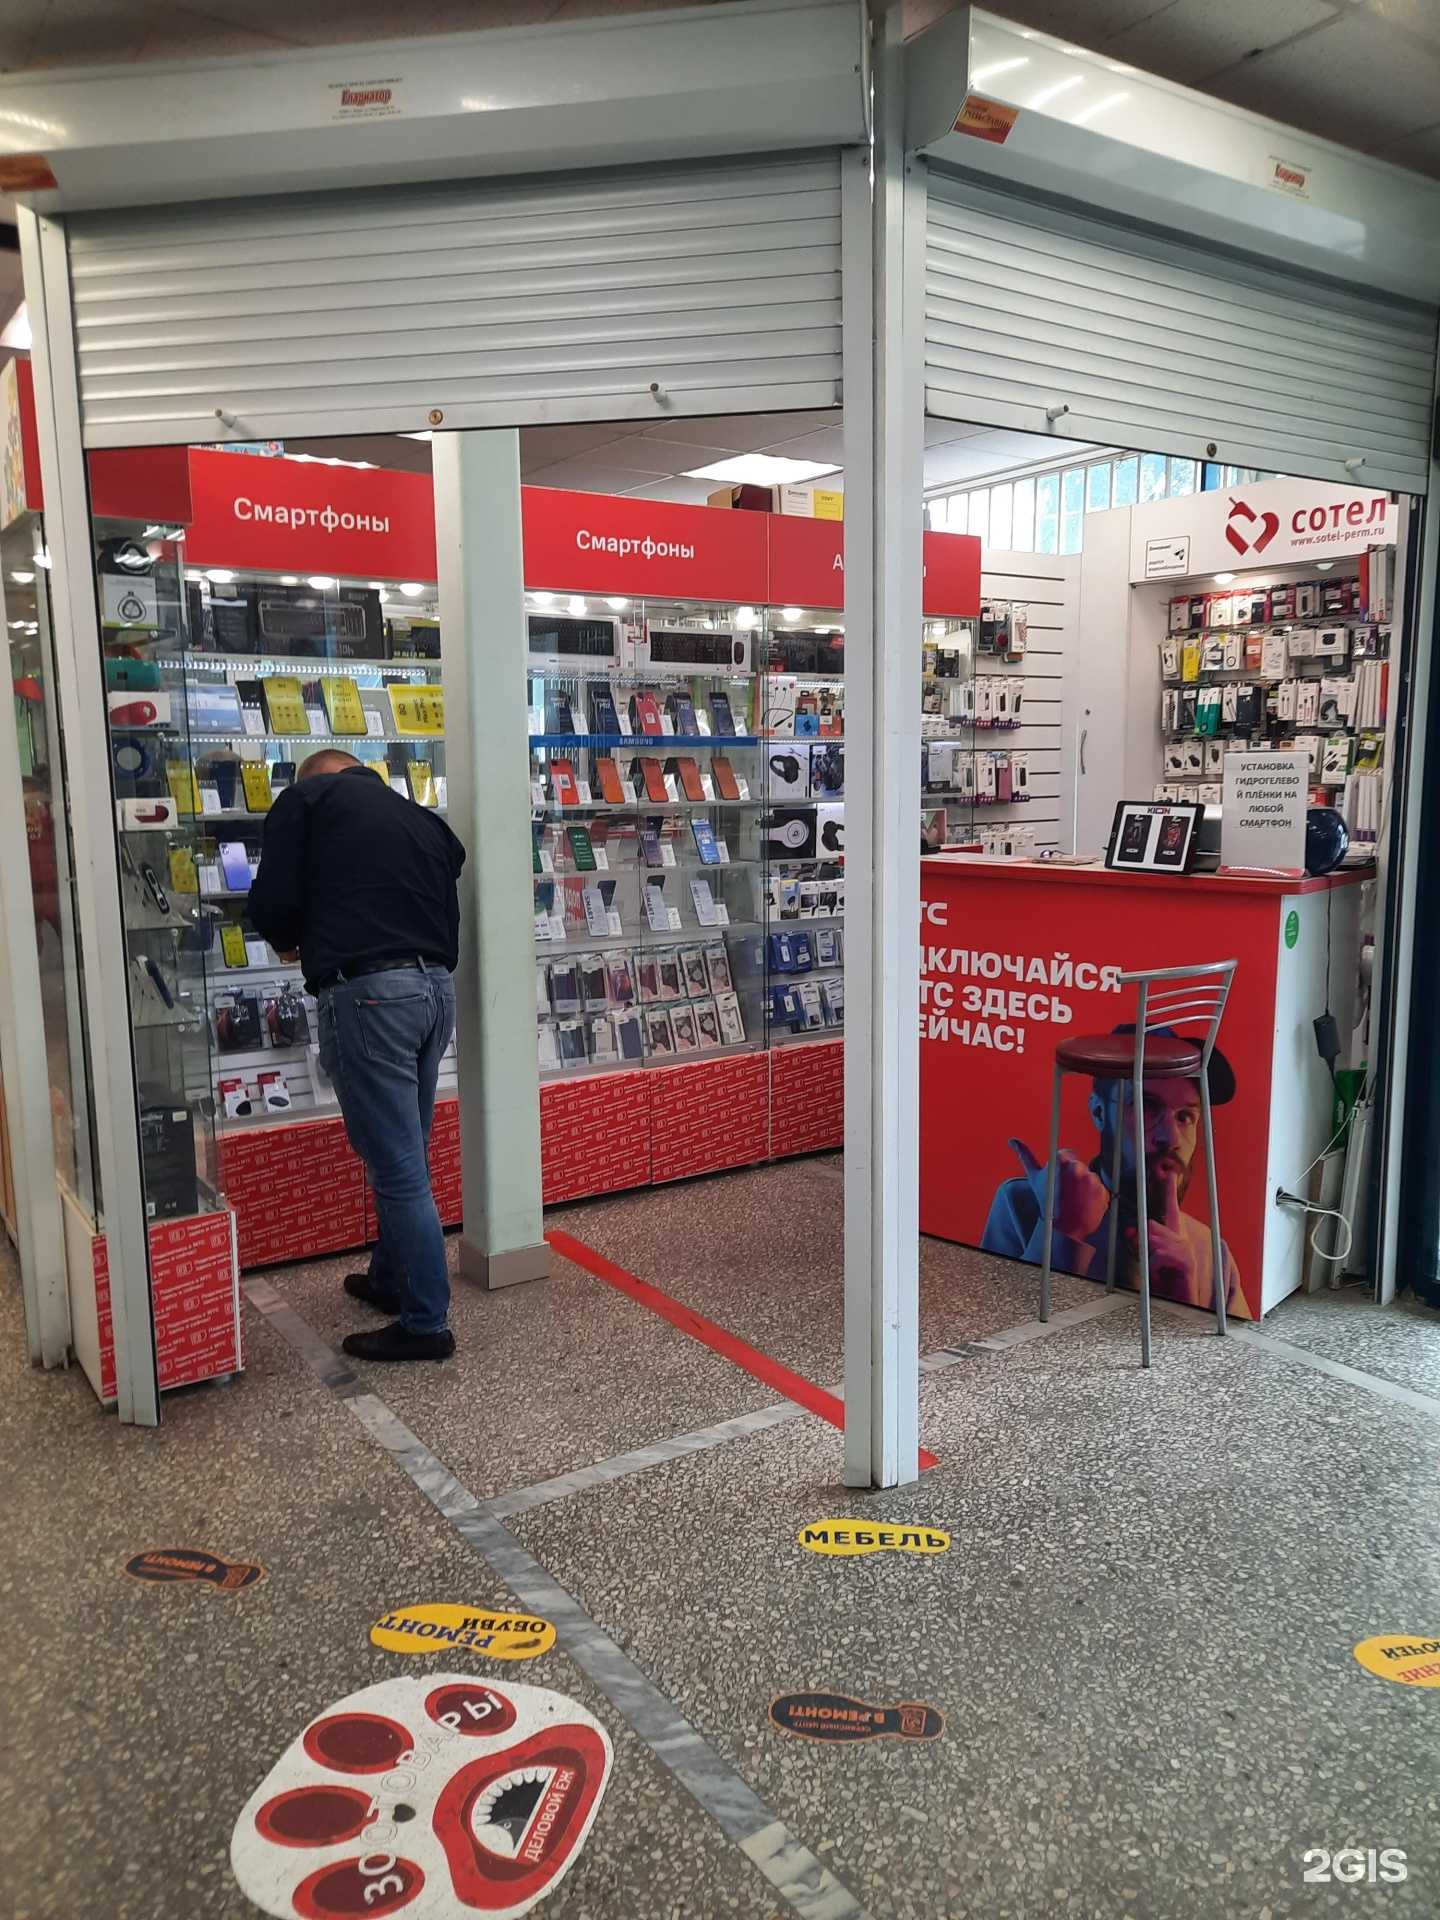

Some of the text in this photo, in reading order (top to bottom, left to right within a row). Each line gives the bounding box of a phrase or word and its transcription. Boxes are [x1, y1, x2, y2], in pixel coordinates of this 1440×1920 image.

[233, 497, 390, 533] Смартфоны
[576, 529, 695, 559] Смартфоны
[1290, 526, 1385, 547] www.sotel-perm.ru
[1240, 763, 1295, 772] УСТАНОВКА
[1235, 776, 1300, 786] ГИДРОГЕЛЕВО
[1284, 791, 1297, 799] НА
[1248, 804, 1284, 813] ЛЮБОЙ
[1239, 819, 1292, 828] СМАРТФОН
[919, 901, 948, 926] ТС
[919, 980, 1073, 1024] ТС ЗДЕСЬ
[918, 1008, 1025, 1054] ЕЙЧАС!
[804, 1530, 946, 1547] МЕБЕЛЬ
[376, 1615, 496, 1649] РЕМОНТ
[459, 1617, 547, 1633] ОБУВИ
[524, 1770, 576, 1863] ДЕЛОВОЙ ЁЖ
